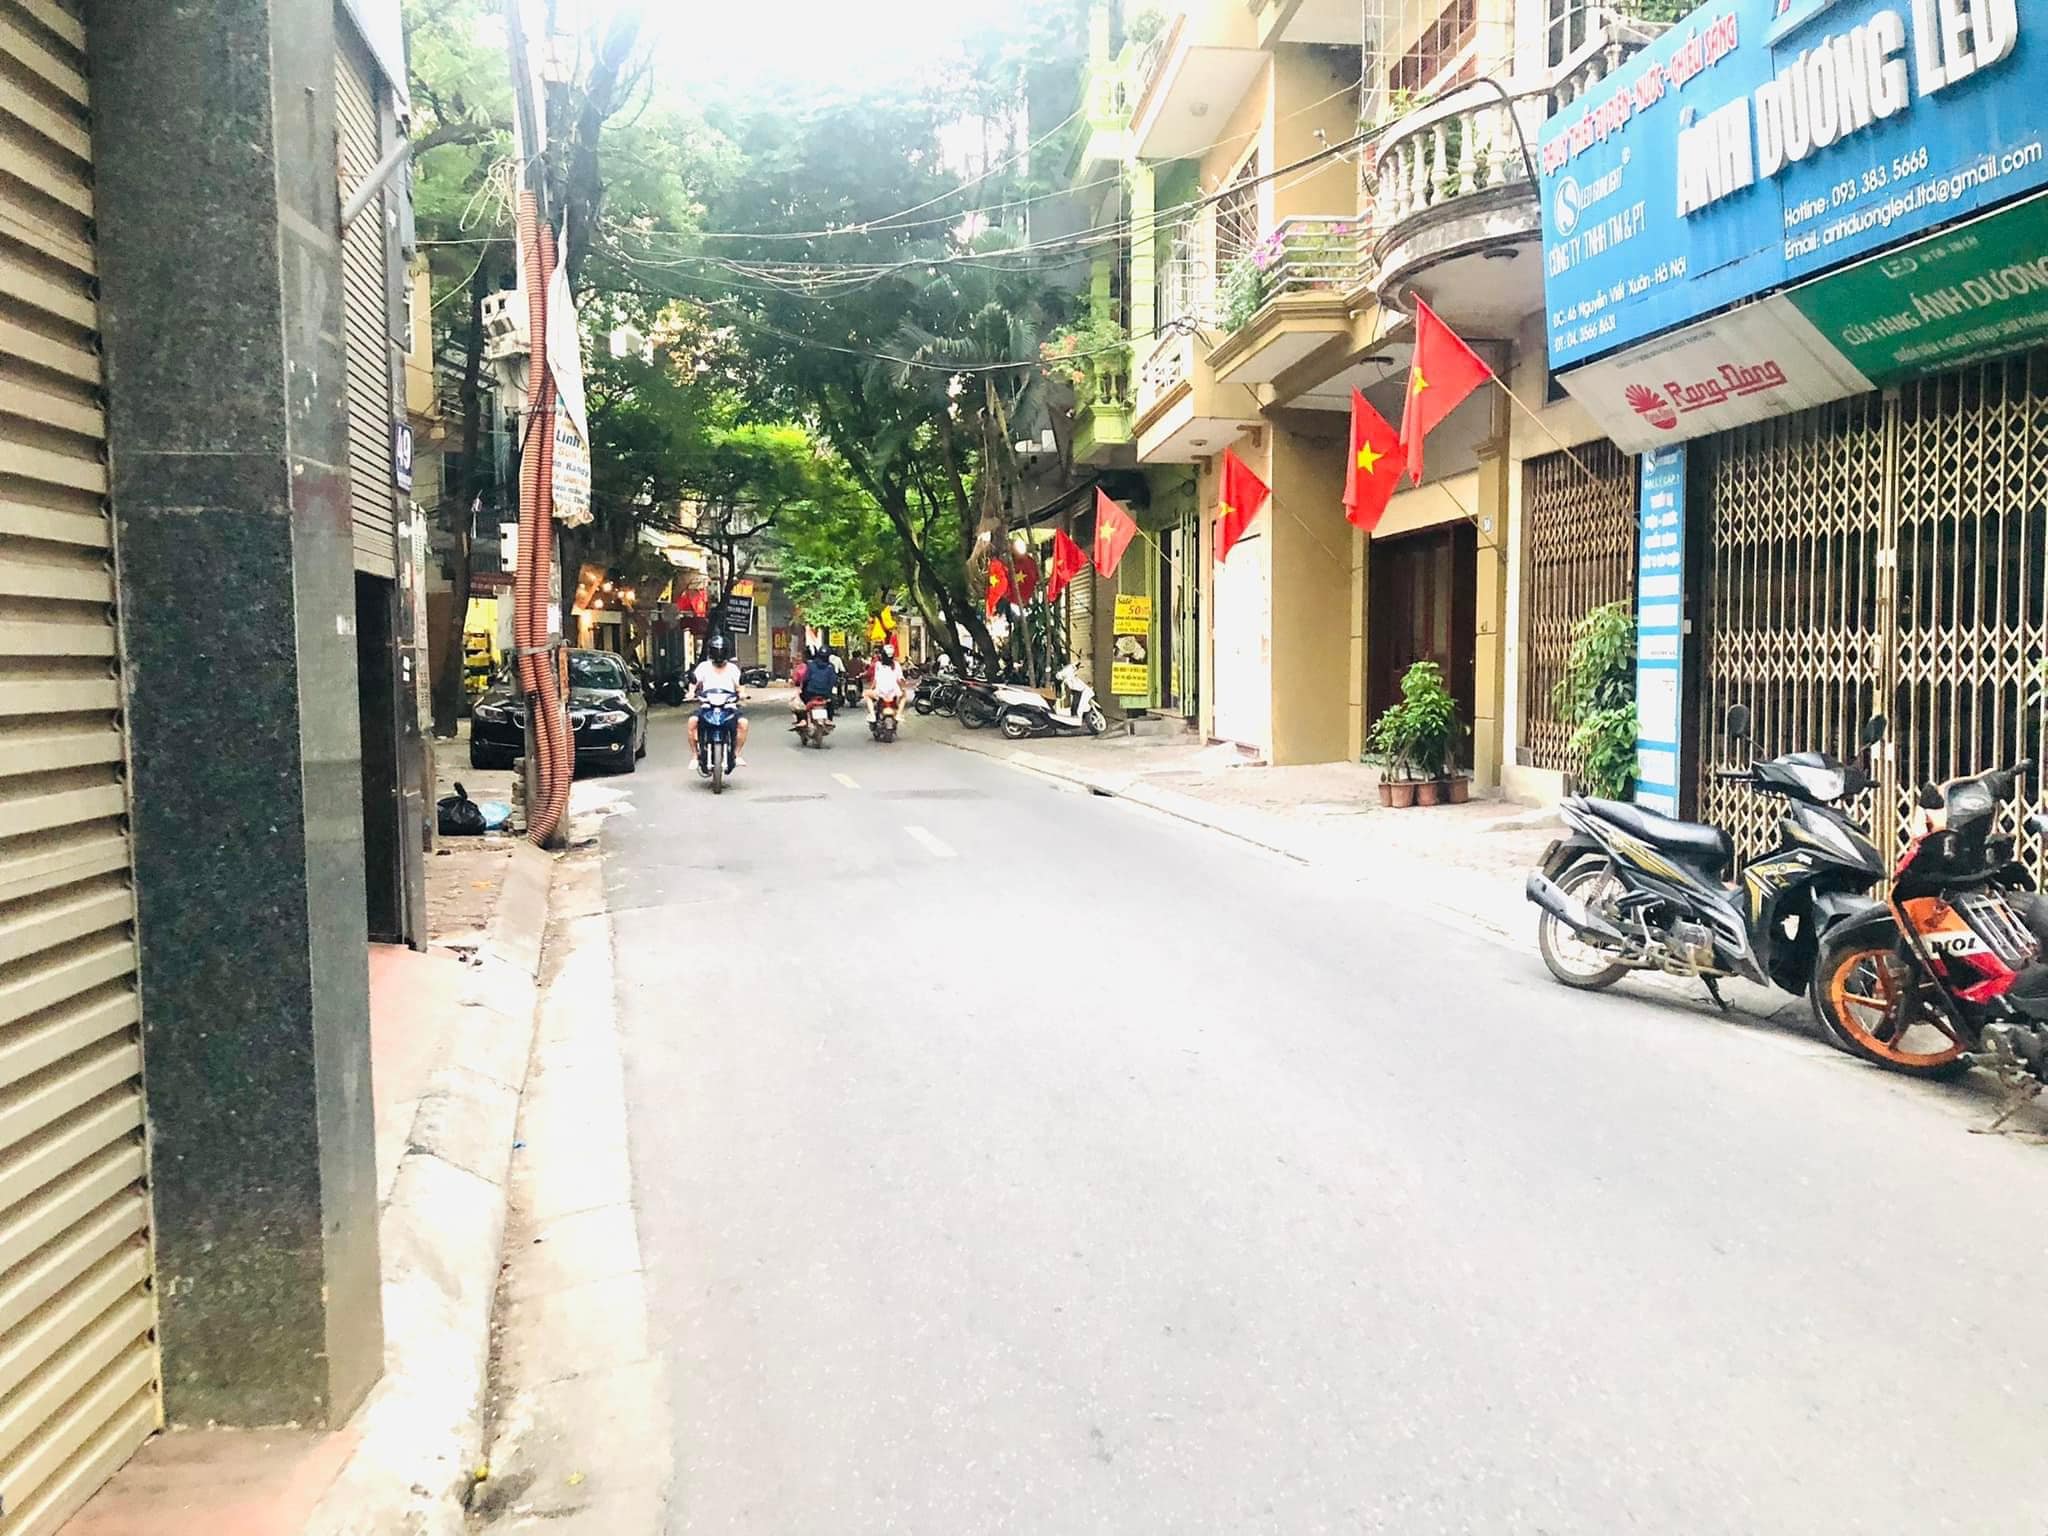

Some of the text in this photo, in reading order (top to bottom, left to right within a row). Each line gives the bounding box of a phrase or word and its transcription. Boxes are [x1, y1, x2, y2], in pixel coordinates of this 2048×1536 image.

[1677, 0, 2018, 218] ÁNH DƯƠNG LED
[1785, 196, 1830, 229] Hotline:
[1892, 146, 1929, 182] 5668
[1785, 142, 2043, 260] Email: anhduongled.ltd@gmail.com
[1570, 236, 1581, 267] TY
[1880, 256, 1918, 280] LED
[1909, 285, 1973, 324] ÁNH
[556, 429, 581, 449] Linh
